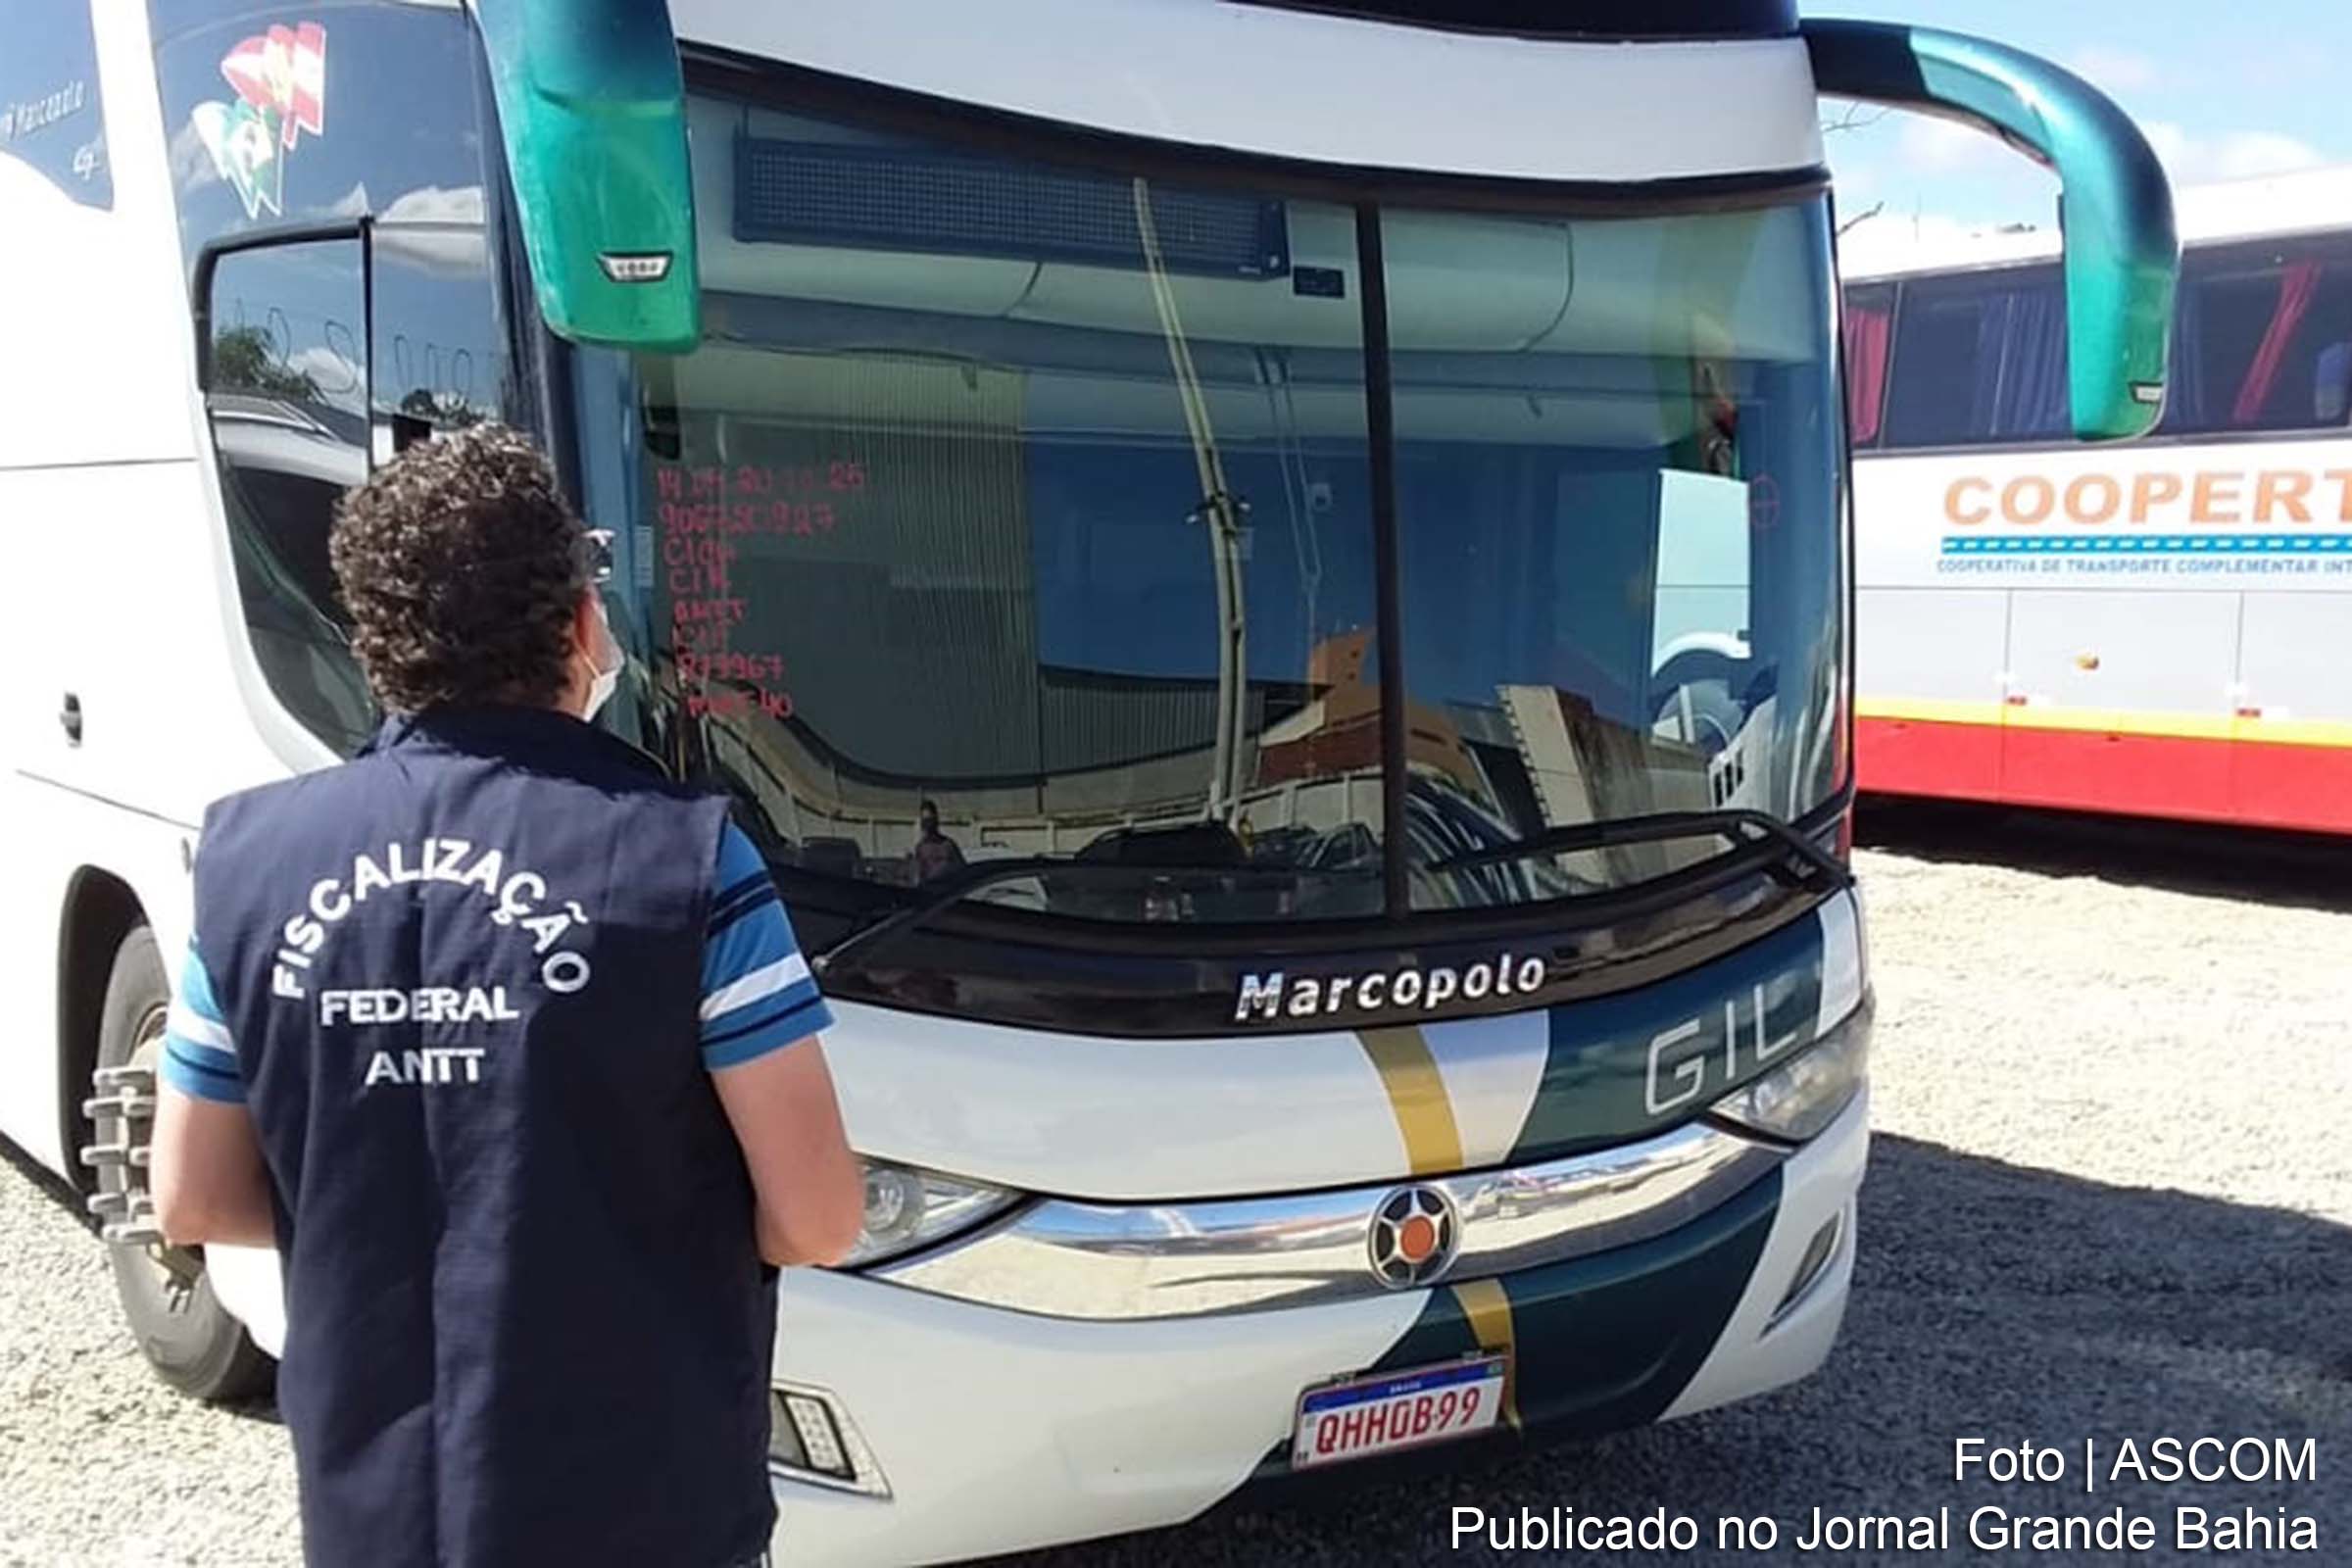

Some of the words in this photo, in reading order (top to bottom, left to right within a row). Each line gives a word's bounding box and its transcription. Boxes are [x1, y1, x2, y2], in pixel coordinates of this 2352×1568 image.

[1936, 559, 2035, 574] COOPERATIVA
[2040, 559, 2062, 574] DE
[2066, 559, 2172, 574] TRANSPORTE
[2176, 558, 2319, 575] COMPLEMENTAR
[271, 837, 590, 1001] FISCALIZAÇÃO
[319, 985, 521, 1027] FEDERAL
[1234, 953, 1546, 1021] Marcopolo
[364, 1047, 486, 1086] ANTT
[1645, 983, 1798, 1116] GIL
